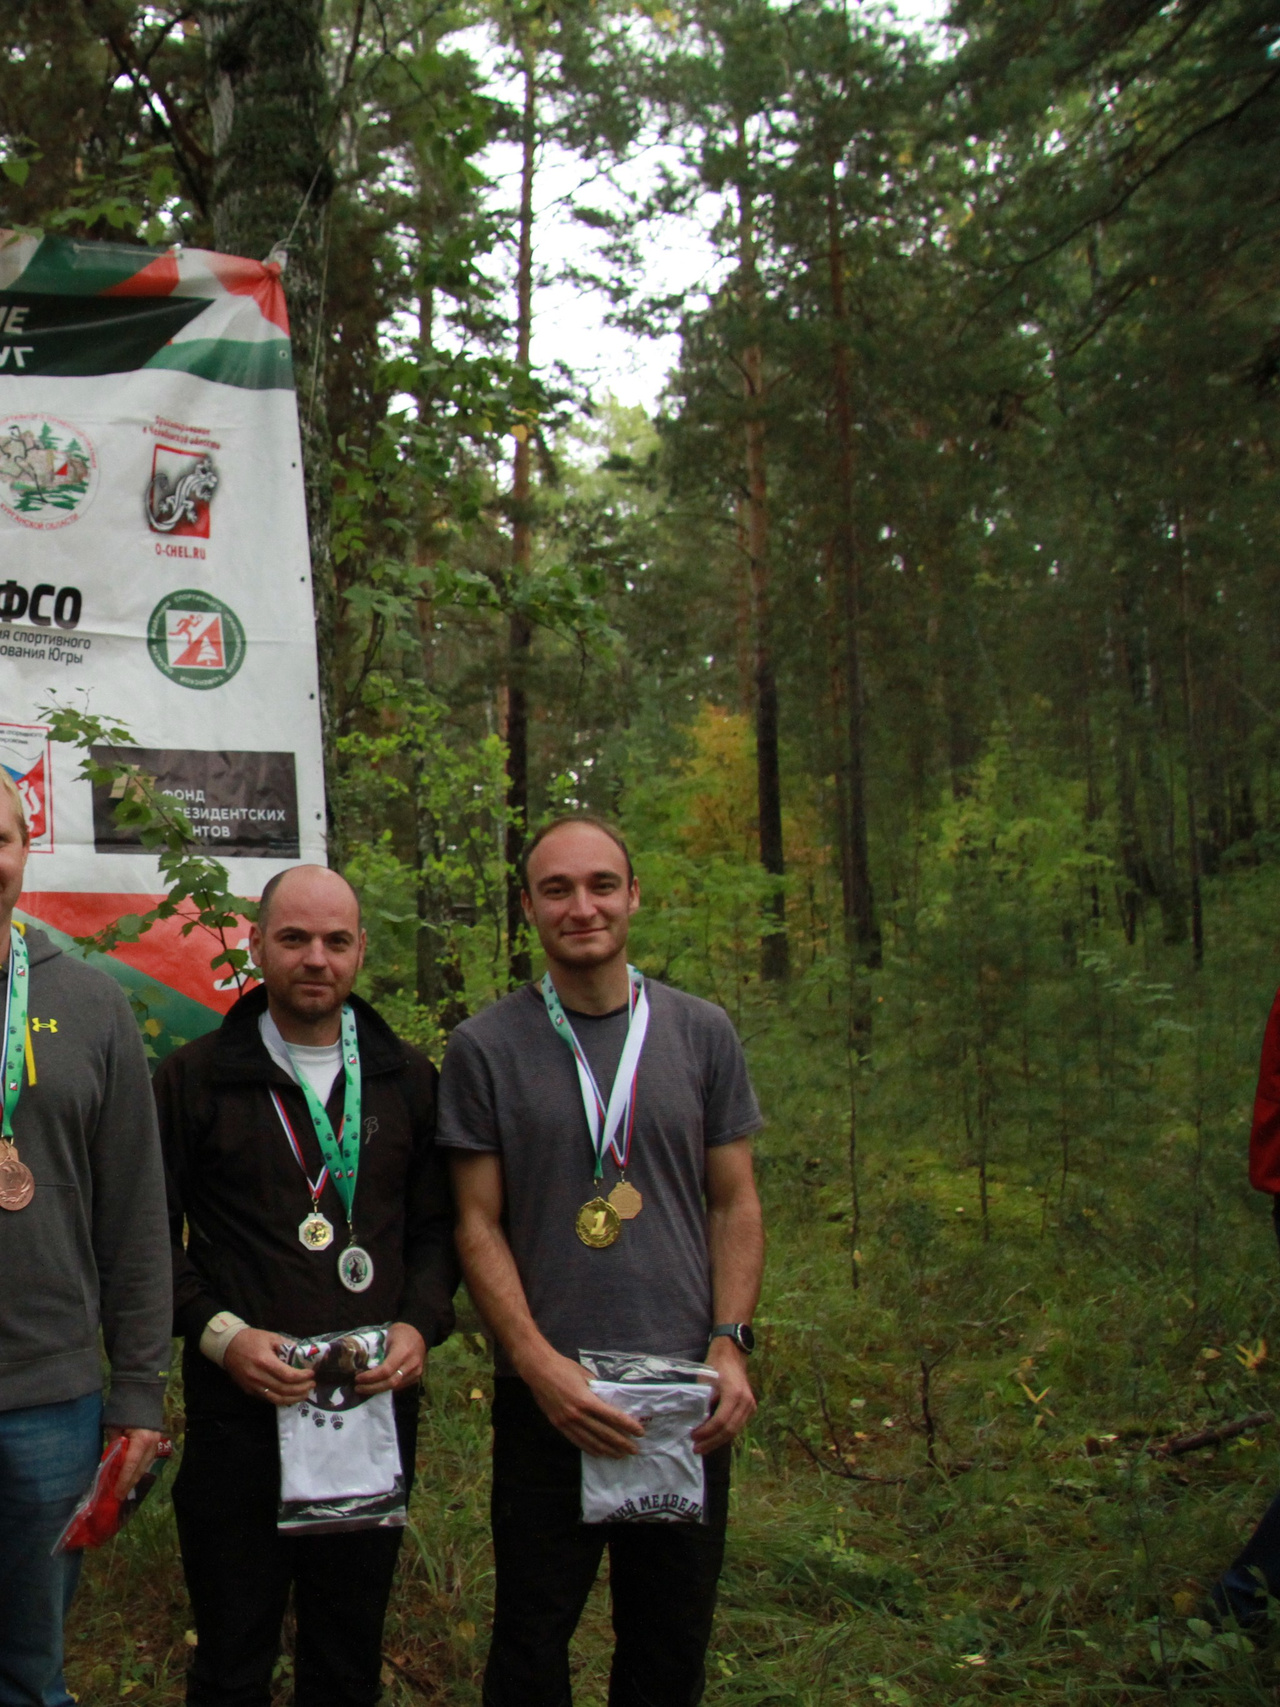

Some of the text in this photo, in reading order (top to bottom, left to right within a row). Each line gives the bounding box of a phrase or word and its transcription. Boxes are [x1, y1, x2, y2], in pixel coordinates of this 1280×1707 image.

[155, 543, 206, 560] O-CHEL.RU
[13, 630, 92, 650] спортивного
[48, 648, 84, 666] Югры
[163, 807, 286, 822] ЕЗИДЕНТСКИХ
[590, 1211, 607, 1235] 1
